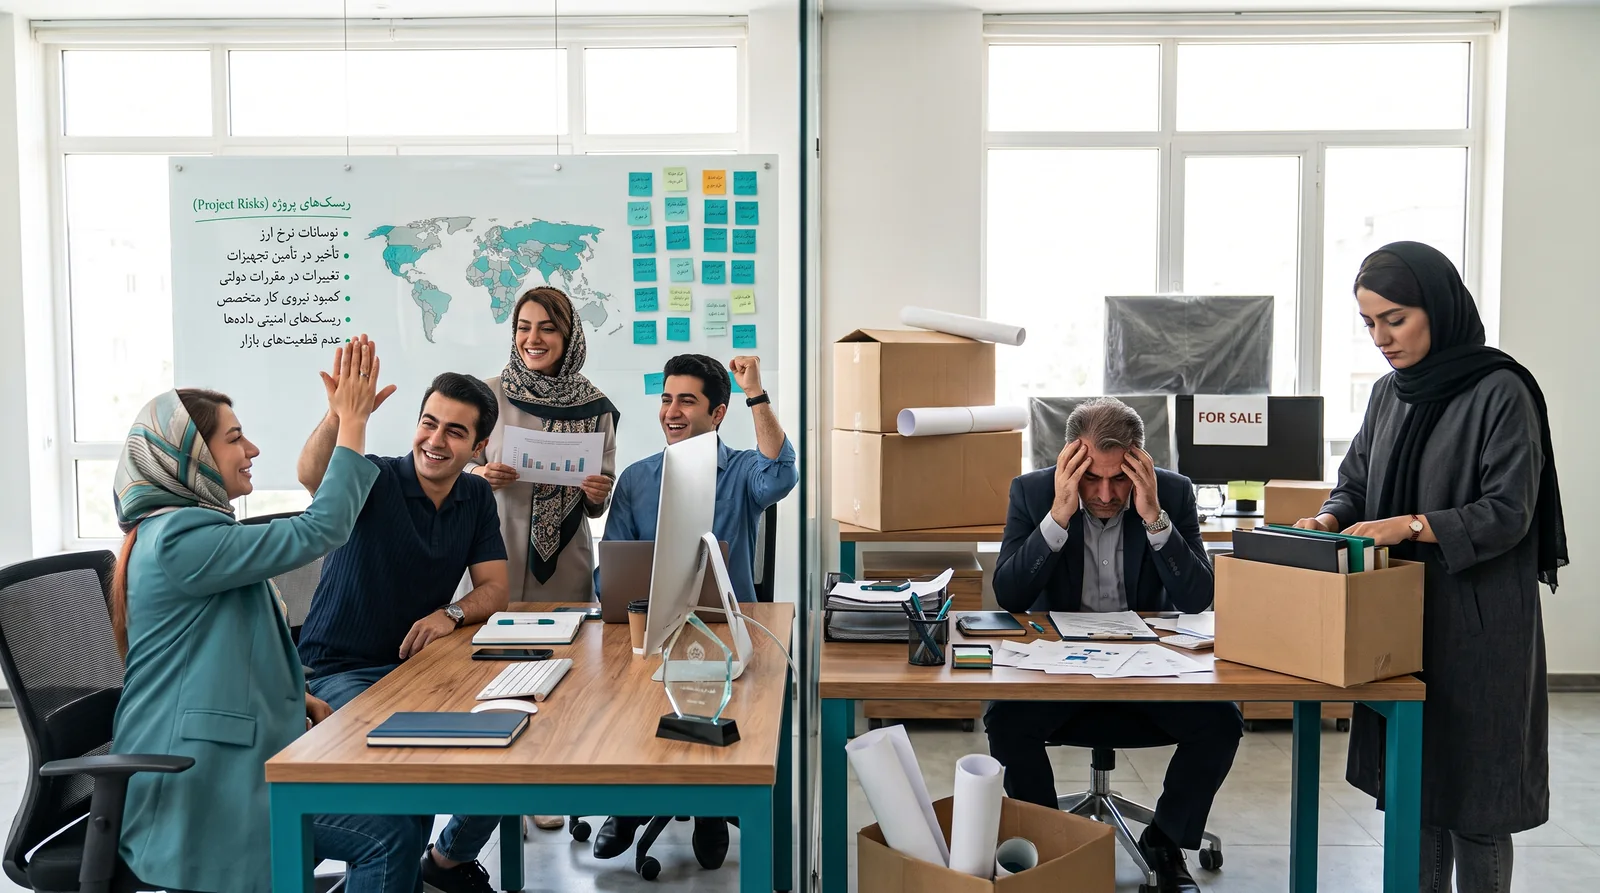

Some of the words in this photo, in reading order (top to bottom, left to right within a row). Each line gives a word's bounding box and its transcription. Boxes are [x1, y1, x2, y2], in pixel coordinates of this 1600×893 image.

[193, 198, 234, 213] (Project
[238, 197, 269, 213] Risks)
[272, 198, 297, 213] پروژه
[260, 226, 274, 242] ارز
[277, 228, 295, 243] نرخ
[298, 226, 339, 242] نوسانات
[227, 249, 269, 265] تجهیزات
[272, 246, 298, 265] تأمین
[301, 251, 312, 264] در
[315, 245, 340, 264] تأخیر
[219, 271, 247, 287] دولتی
[249, 271, 286, 285] مقررات
[288, 272, 300, 285] در
[302, 270, 340, 285] تغییرات
[216, 292, 261, 308] متخصص
[264, 291, 279, 306] کار
[282, 292, 310, 306] نیروی
[313, 290, 341, 306] کمبود
[257, 312, 287, 328] امنیتی
[239, 334, 260, 349] بازار
[321, 335, 342, 349] عدم
[1198, 411, 1226, 424] FOR
[1229, 411, 1263, 424] SALE
